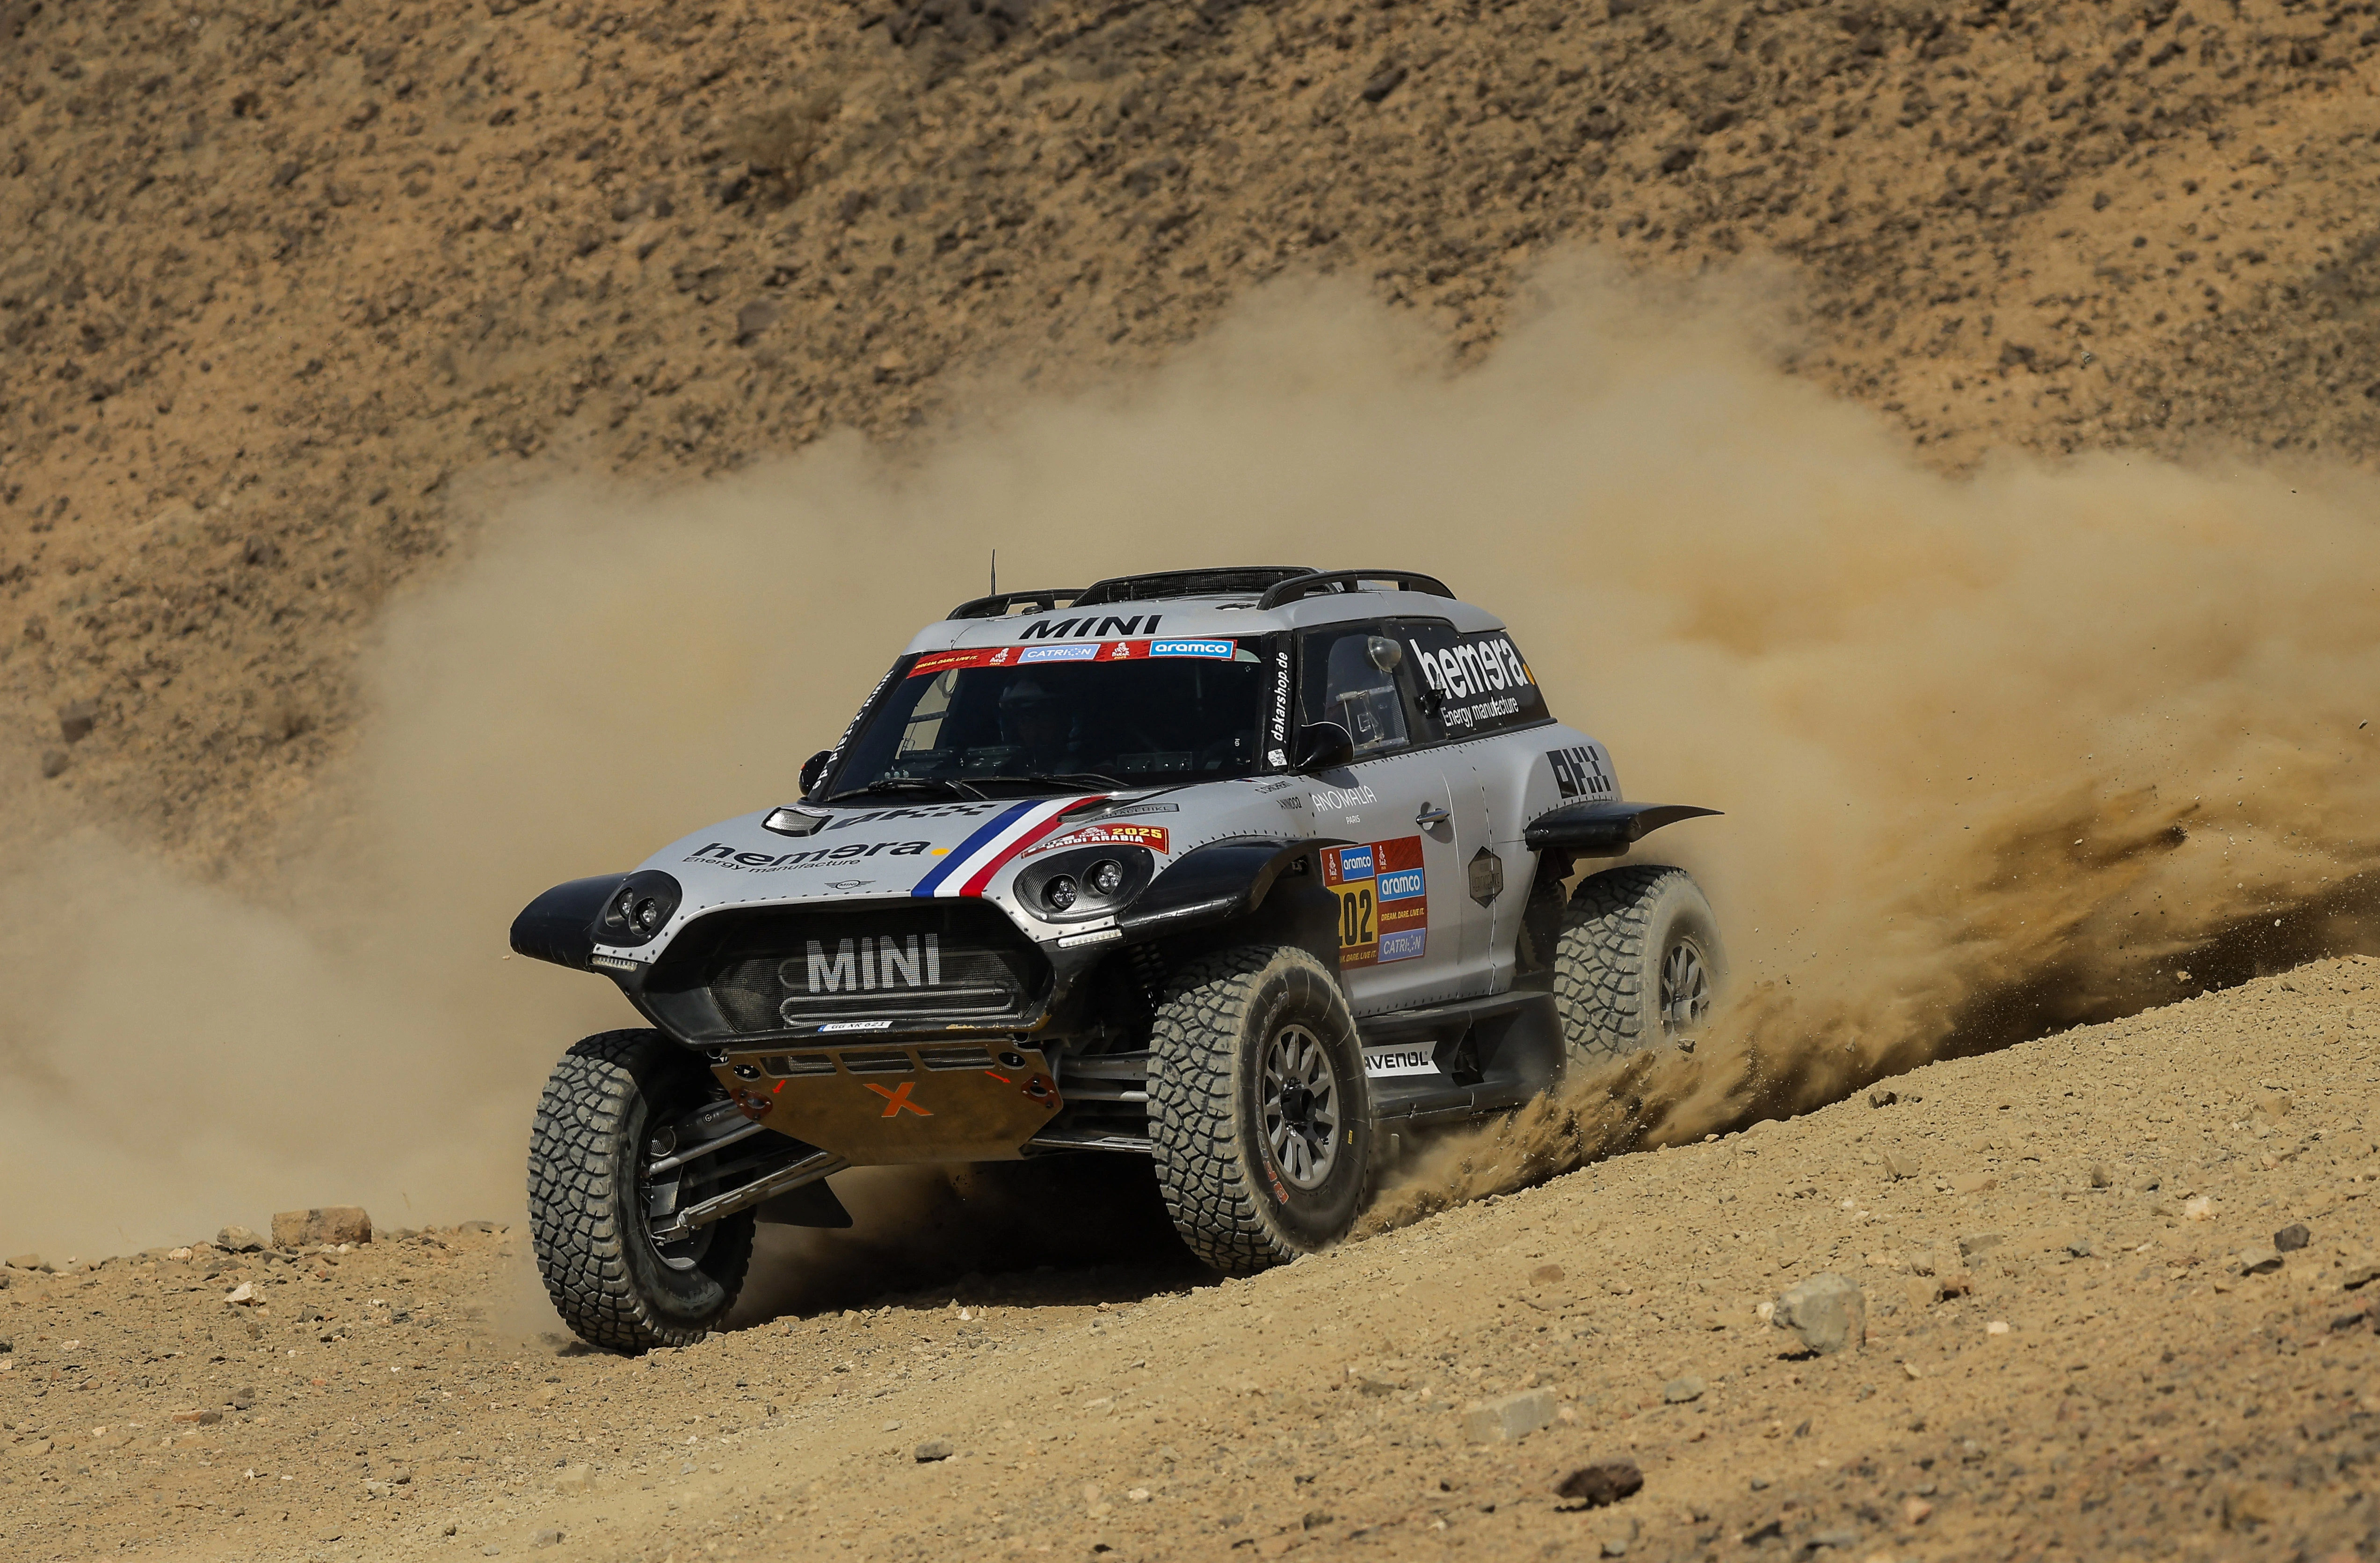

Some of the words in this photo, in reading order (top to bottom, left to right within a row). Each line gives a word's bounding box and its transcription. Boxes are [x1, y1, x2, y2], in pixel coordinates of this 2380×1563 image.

[1018, 615, 1163, 640] MINI
[1027, 648, 1092, 658] CATRION
[1155, 642, 1227, 653] aramco
[1271, 652, 1290, 742] dakarshop.de
[1440, 707, 1473, 728] Energy
[1472, 696, 1519, 721] manufacture
[812, 670, 894, 790] www.x-raid.de
[1312, 785, 1378, 812] ANOMALIA
[1346, 815, 1360, 825] PARIS
[1046, 837, 1087, 849] SAUDI
[1112, 828, 1162, 839] 2025
[682, 857, 746, 870] Energy
[748, 859, 861, 873] manufacture
[1343, 856, 1371, 870] aramco
[1382, 875, 1421, 895] aramco
[1381, 912, 1397, 921] DREAM.
[1384, 935, 1421, 955] CATRION
[806, 933, 940, 993] MINI
[1365, 1051, 1429, 1070] AVENOL
